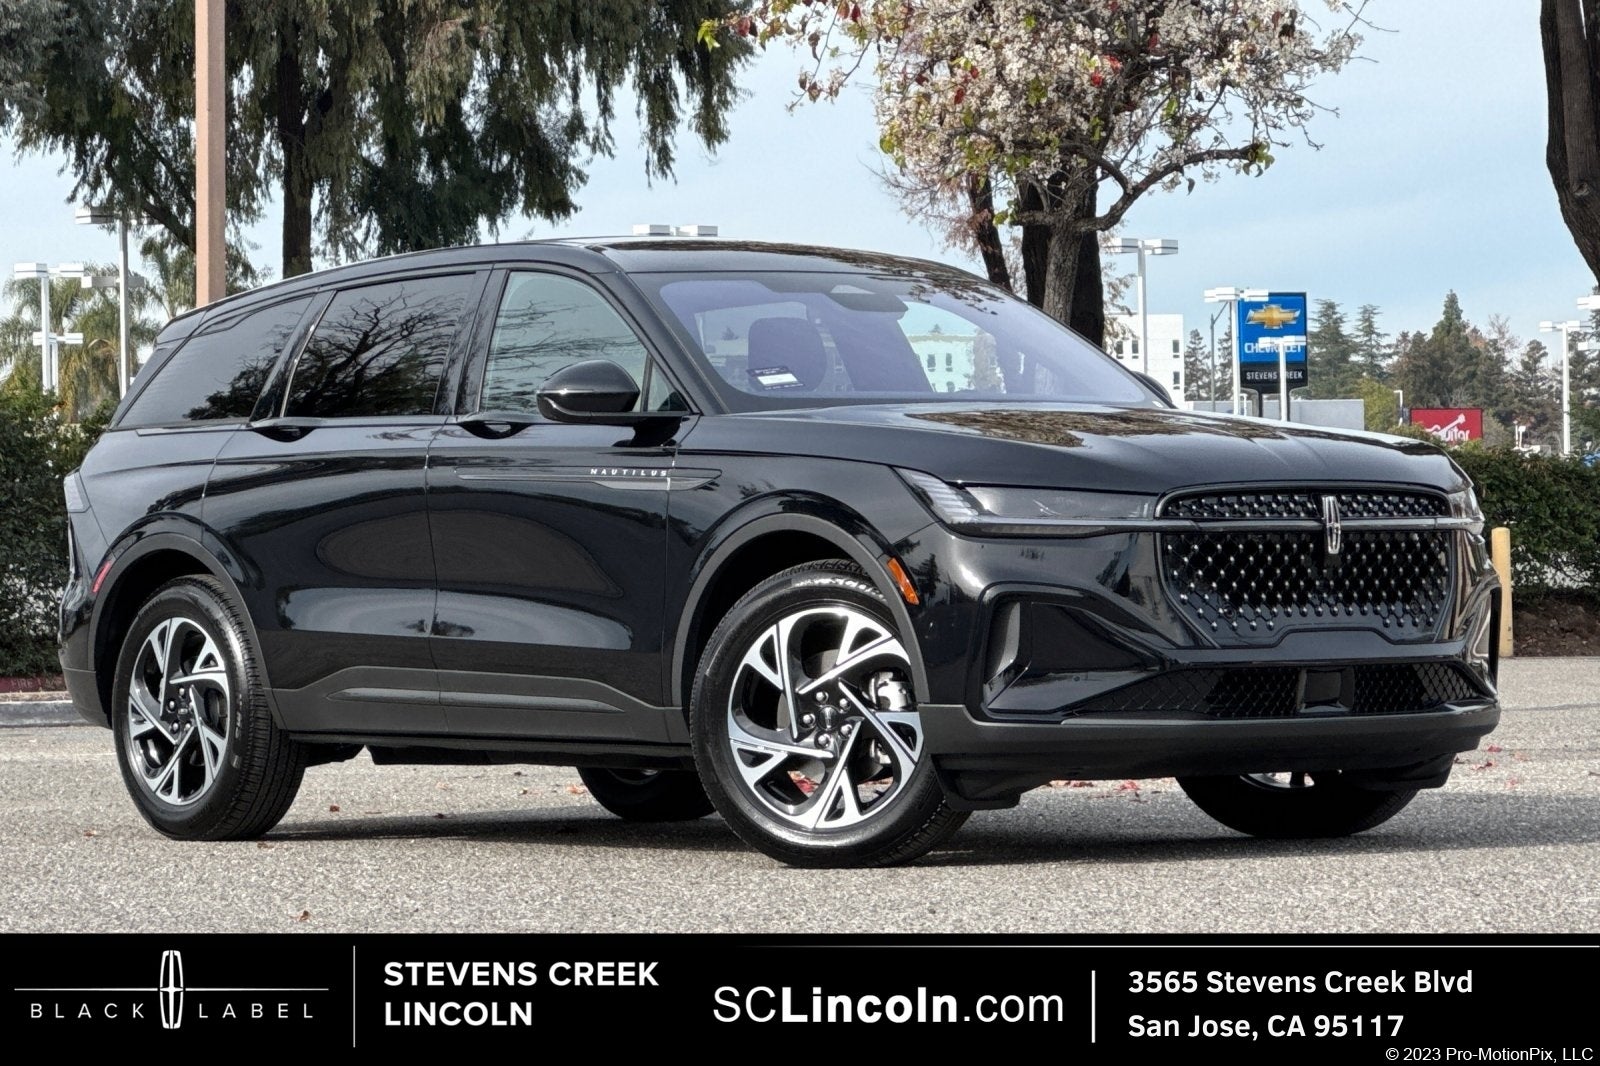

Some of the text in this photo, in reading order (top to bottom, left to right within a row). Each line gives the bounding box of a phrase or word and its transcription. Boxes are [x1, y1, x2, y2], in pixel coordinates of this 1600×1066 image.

[1244, 342, 1302, 353] CHEVRLET
[1246, 370, 1303, 380] STEVENS REEK
[590, 468, 667, 477] NAUTILUS
